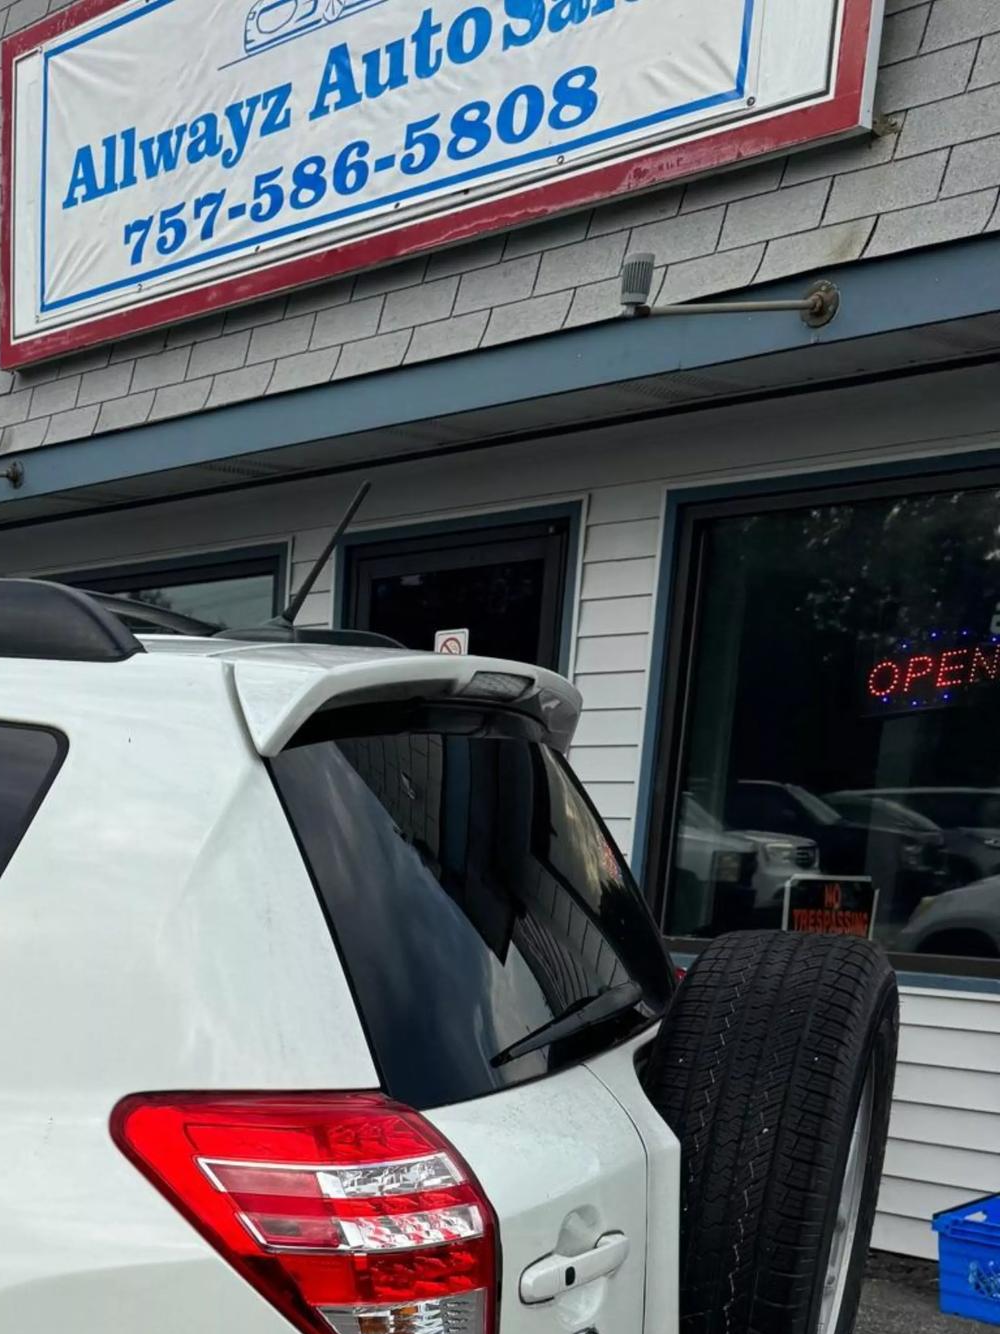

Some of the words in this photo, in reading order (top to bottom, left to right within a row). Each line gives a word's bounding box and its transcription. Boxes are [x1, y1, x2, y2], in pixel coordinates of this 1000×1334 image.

[62, 82, 292, 210] Allwayz
[123, 65, 599, 266] 757-586-5808
[868, 644, 1000, 696] OPEN
[824, 883, 841, 909] NO
